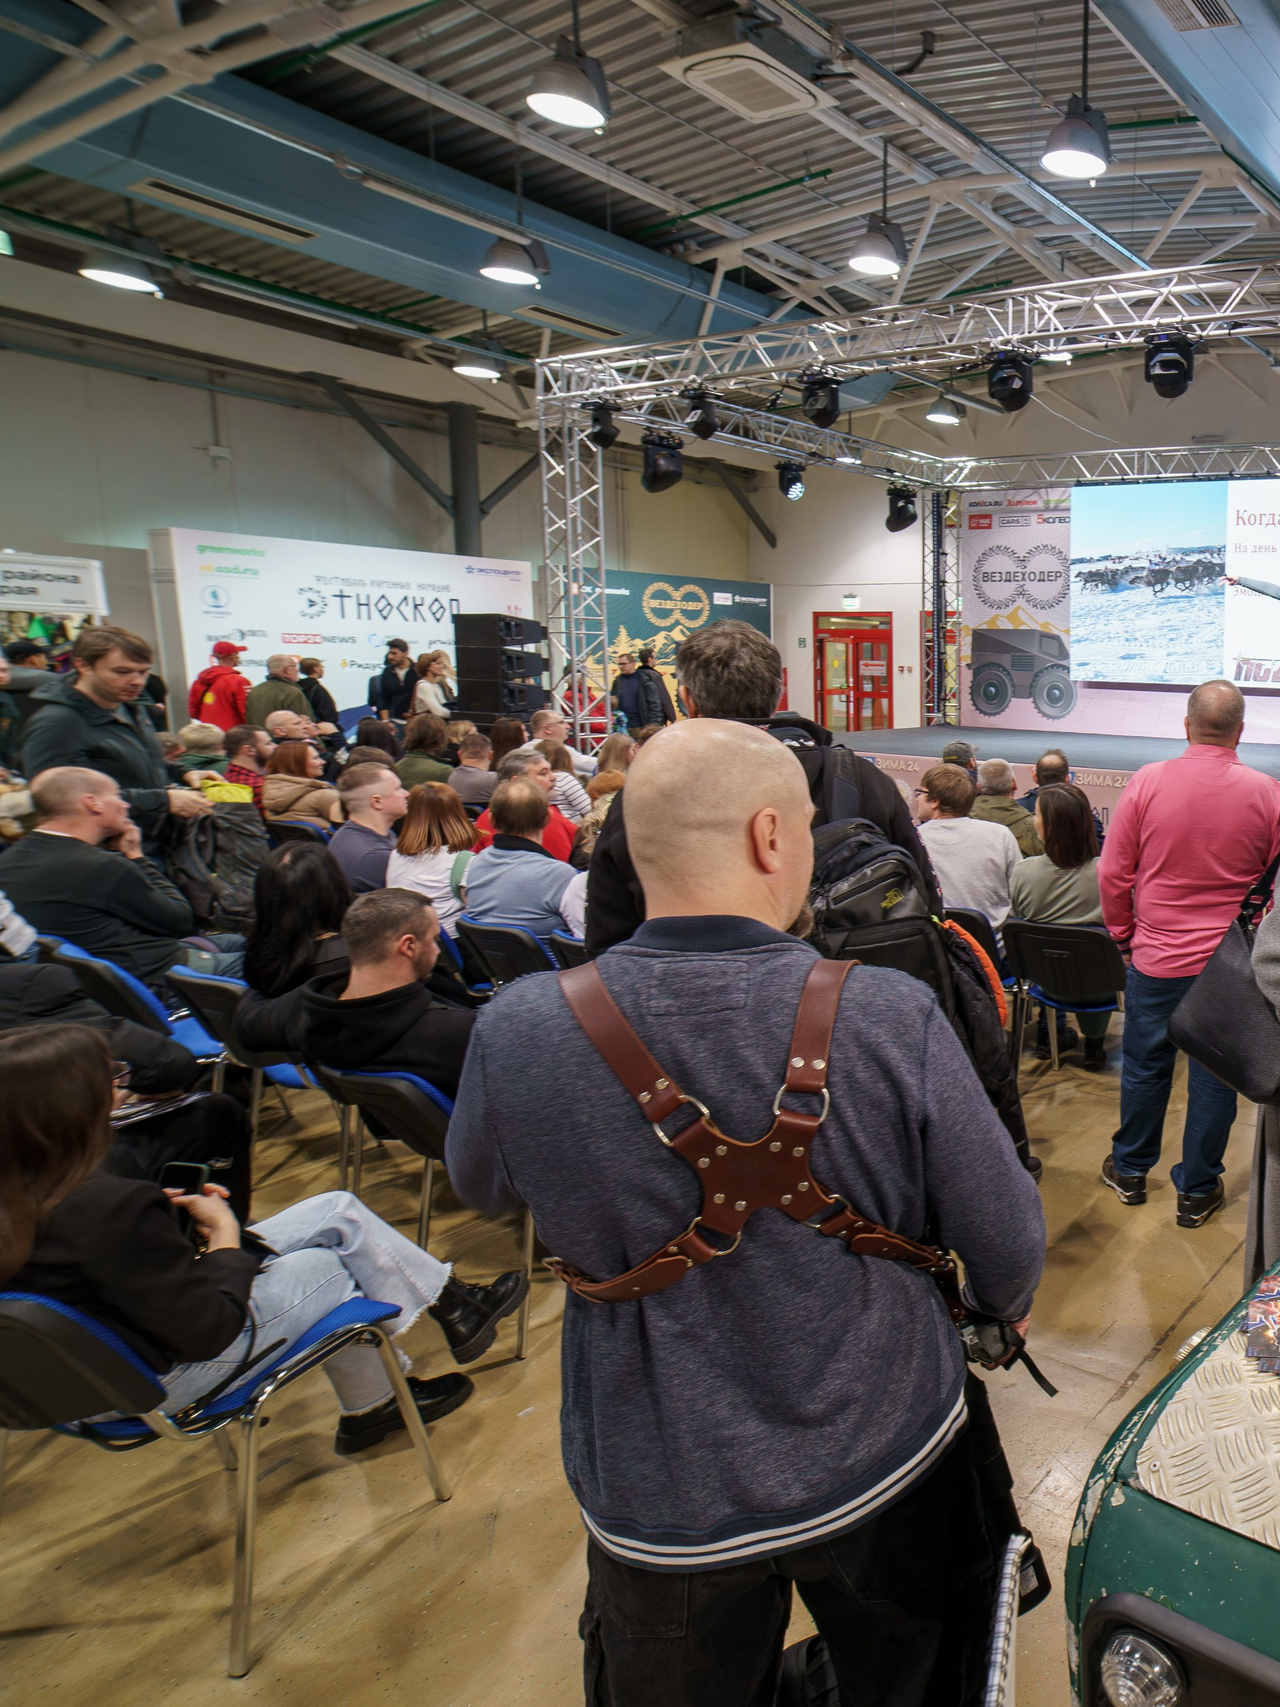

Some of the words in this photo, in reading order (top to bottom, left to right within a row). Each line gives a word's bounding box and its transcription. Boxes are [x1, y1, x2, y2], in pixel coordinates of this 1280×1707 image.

[1234, 543, 1248, 553] На
[1251, 544, 1277, 553] день
[1, 570, 82, 583] района
[982, 570, 1063, 583] ВЕЗДЕХОДЕР
[876, 759, 905, 770] ЗИМА
[907, 761, 920, 771] 24
[1075, 773, 1112, 787] ЗИМА
